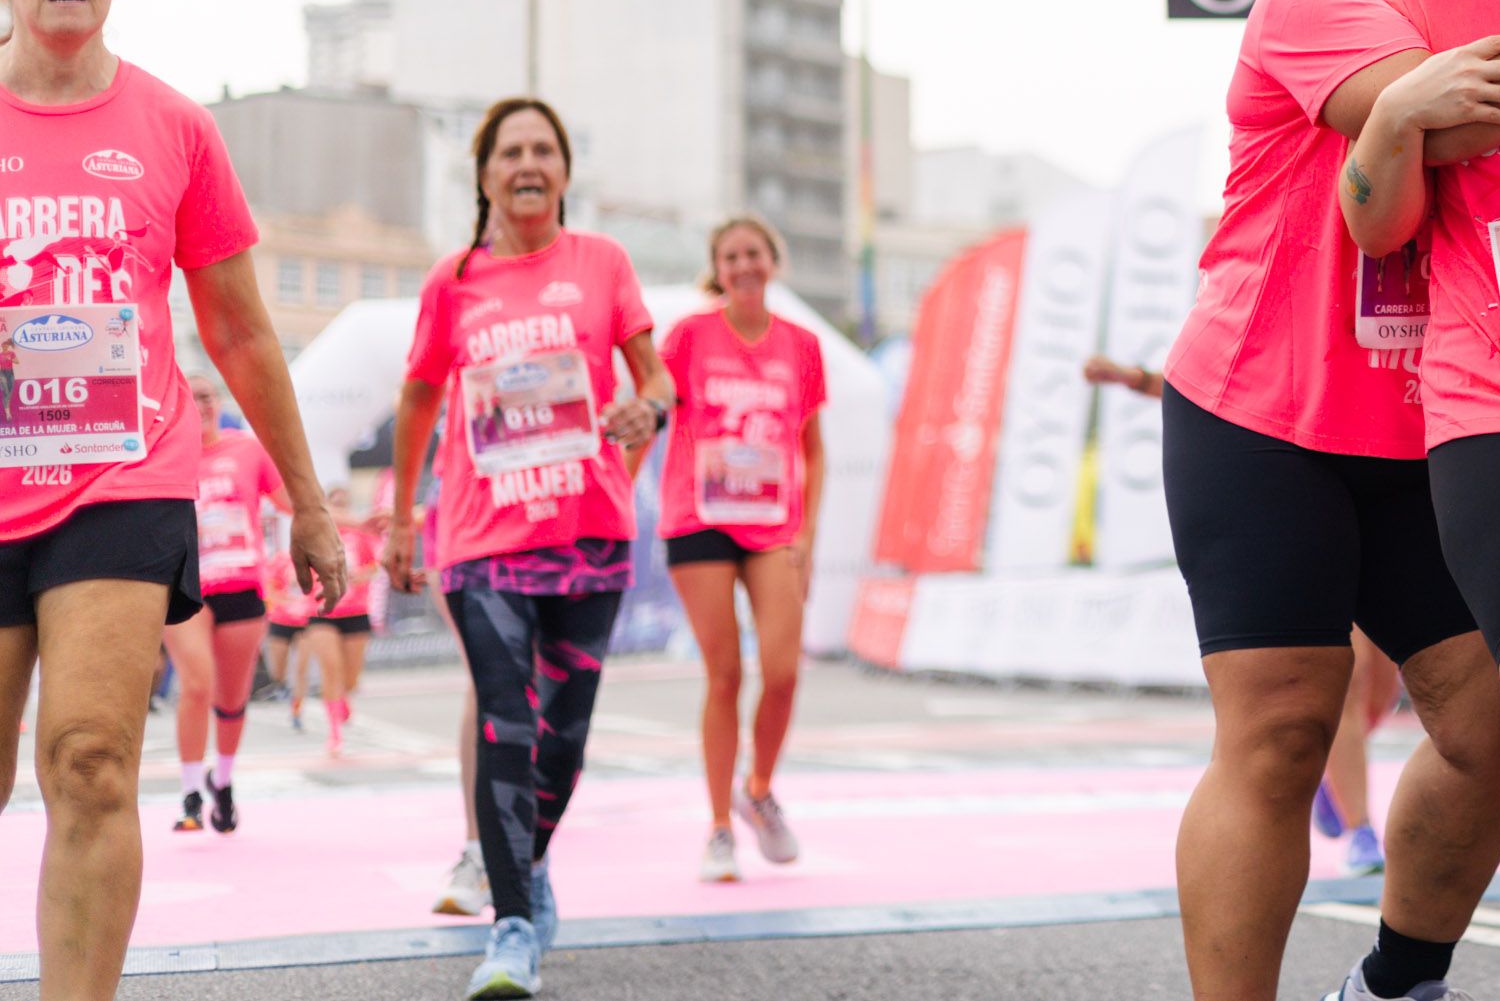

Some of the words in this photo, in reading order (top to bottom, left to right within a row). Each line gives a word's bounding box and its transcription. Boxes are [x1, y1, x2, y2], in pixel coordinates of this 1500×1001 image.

[88, 158, 140, 176] ASTURIANA
[1374, 303, 1413, 315] CARRERA
[1415, 303, 1425, 313] DE
[19, 329, 88, 344] ASTURIANA
[467, 312, 577, 362] CARRERA
[19, 377, 89, 406] 016
[38, 409, 71, 422] 1509
[504, 403, 554, 431] 016
[19, 426, 31, 435] DE
[33, 425, 45, 434] LA
[47, 423, 77, 433] MUJER
[84, 423, 92, 432] A
[93, 420, 126, 431] CORUÑA
[0, 443, 38, 458] SHO
[74, 442, 124, 454] Santander
[21, 465, 73, 486] 2026
[490, 460, 586, 509] MUJER
